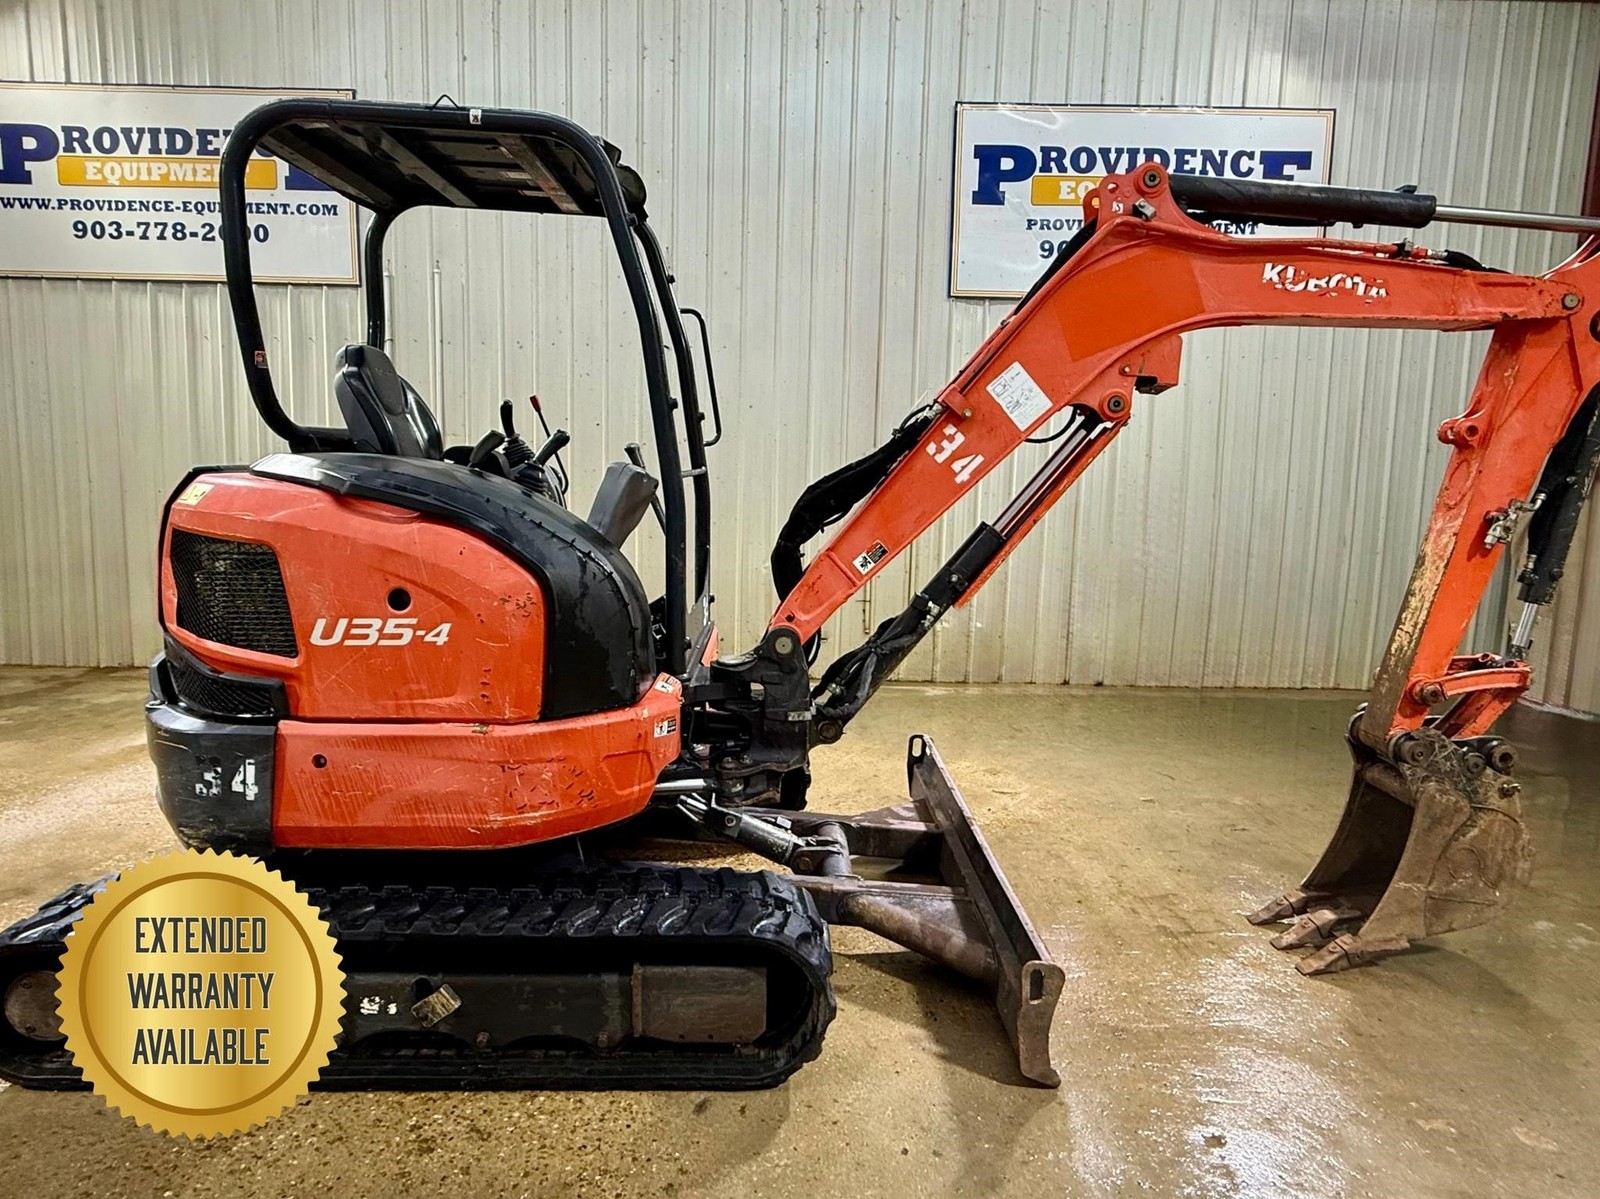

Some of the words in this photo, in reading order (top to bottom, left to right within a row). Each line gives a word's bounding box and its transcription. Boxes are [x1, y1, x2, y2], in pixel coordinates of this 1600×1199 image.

[84, 161, 249, 186] EQUIPME
[926, 424, 985, 484] 34
[309, 618, 452, 646] U35-4
